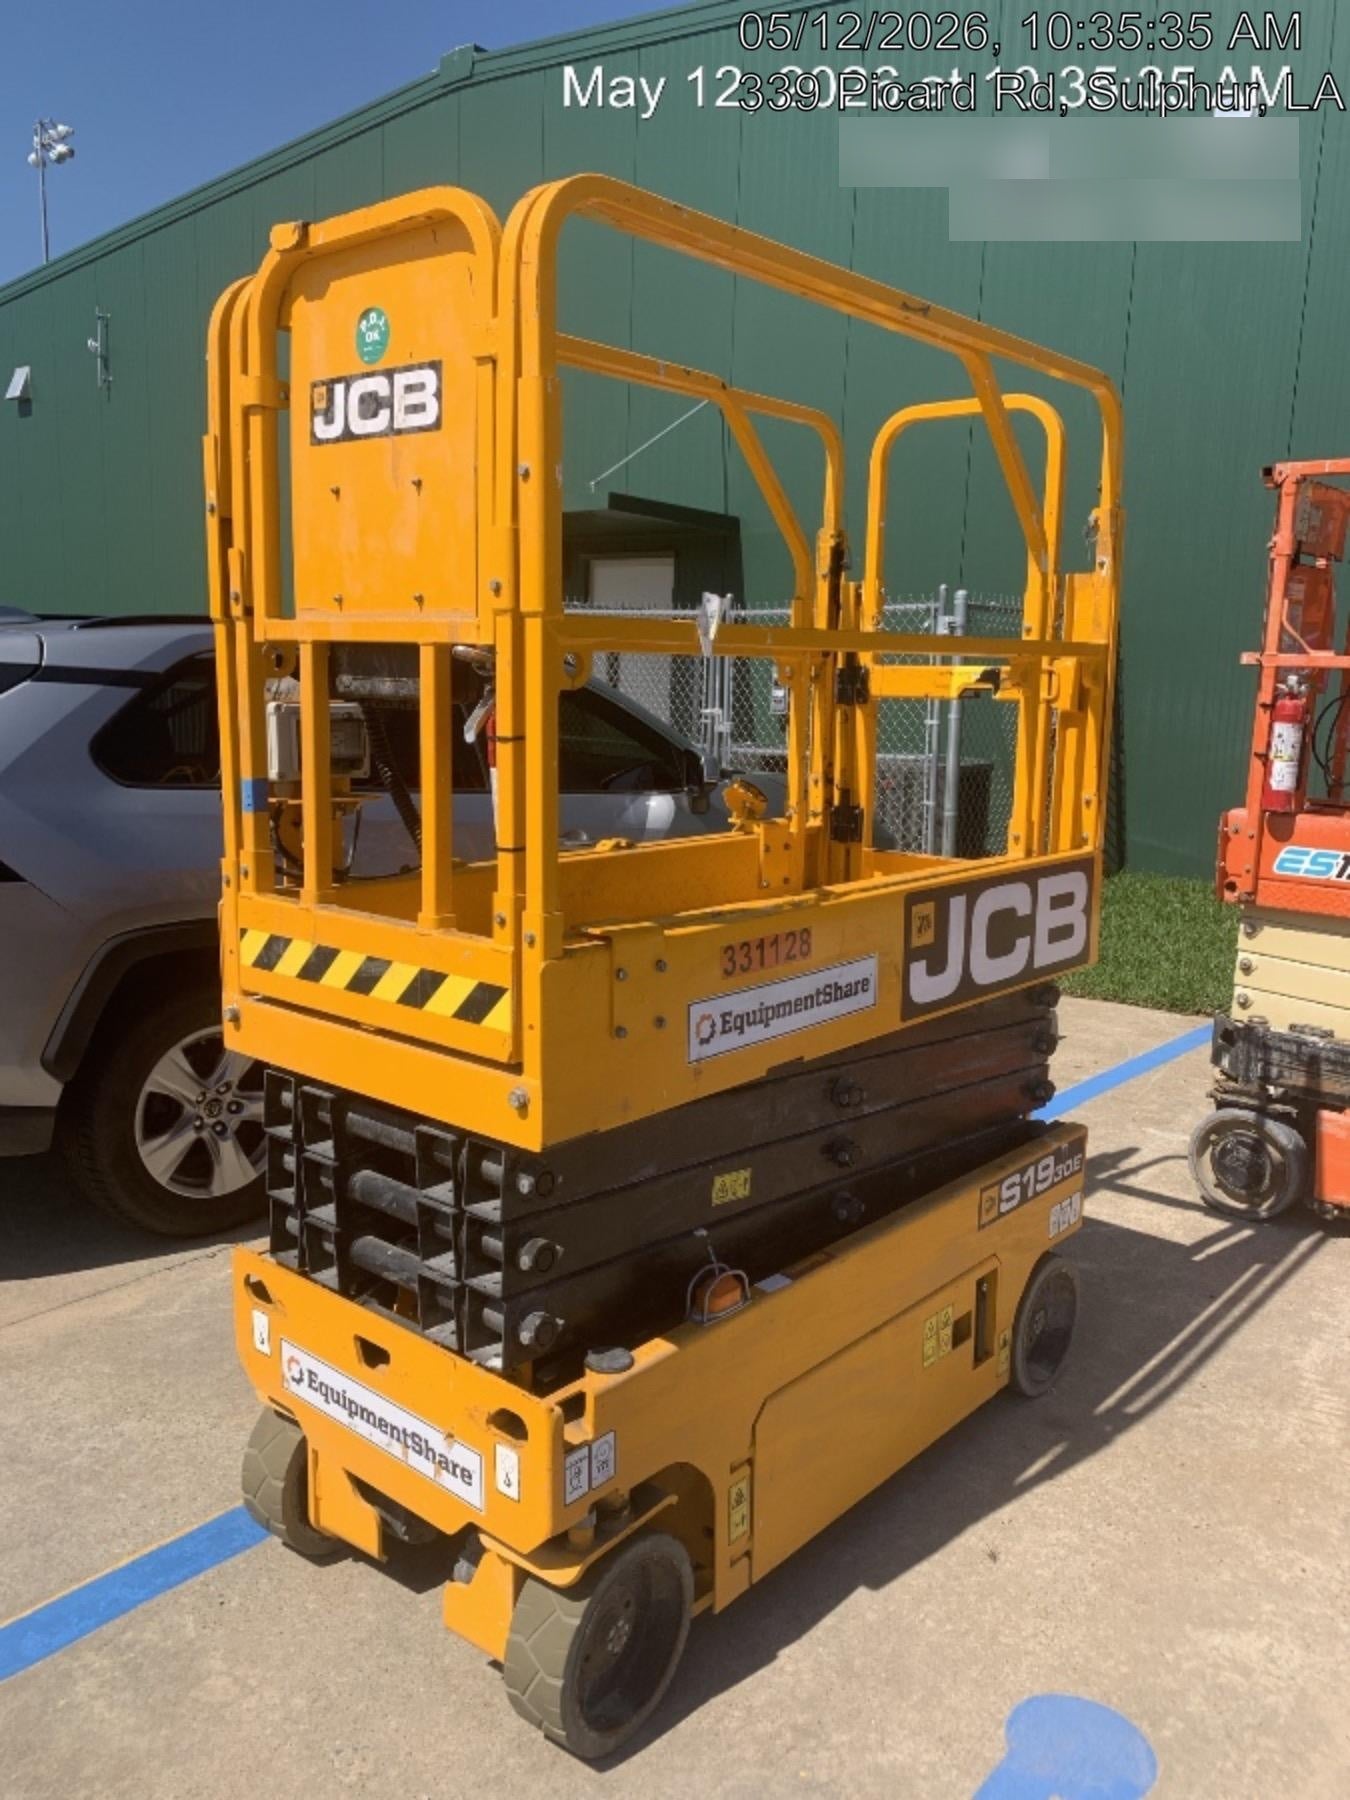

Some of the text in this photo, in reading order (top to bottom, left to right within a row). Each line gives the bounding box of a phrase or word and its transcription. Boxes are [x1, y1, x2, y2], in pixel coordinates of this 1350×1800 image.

[313, 368, 439, 439] JCB
[1275, 847, 1350, 879] ES1
[722, 927, 812, 977] 331128
[909, 871, 1087, 1004] JCB
[719, 976, 871, 1036] EquipmentShare
[306, 1368, 473, 1487] EquipmentShare
